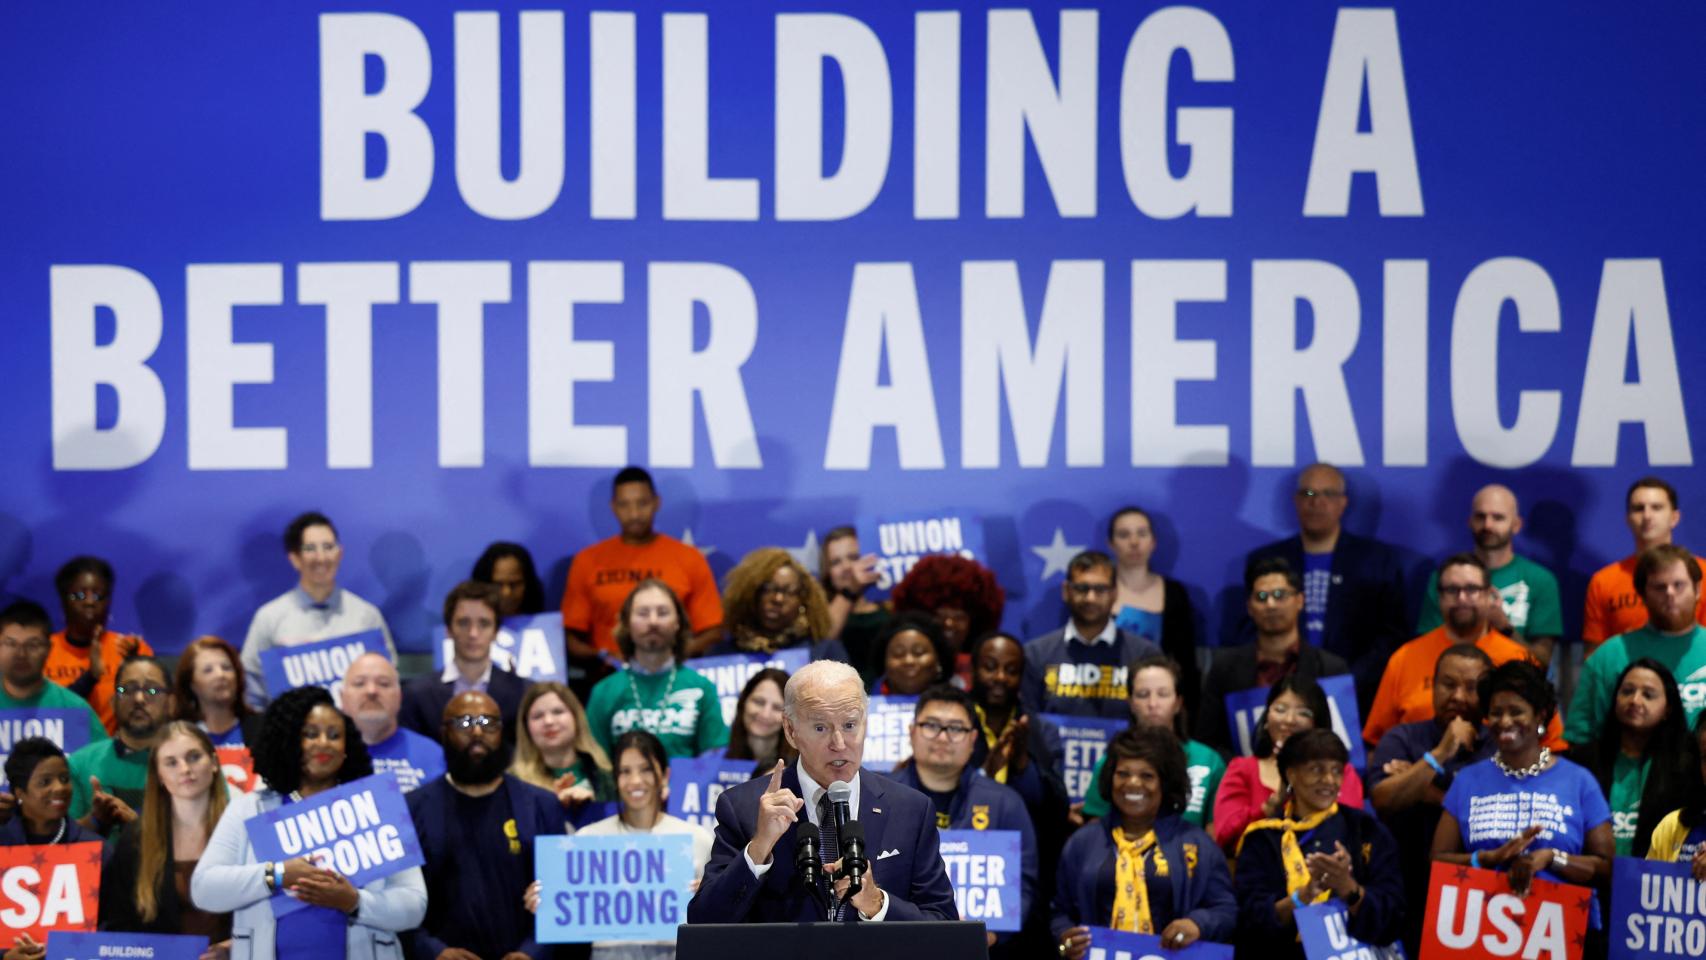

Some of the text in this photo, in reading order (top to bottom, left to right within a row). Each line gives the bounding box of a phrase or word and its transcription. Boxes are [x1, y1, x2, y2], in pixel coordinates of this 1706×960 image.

[319, 8, 1425, 220] BUILDING A
[50, 258, 1693, 471] BETTER AMERICA
[878, 517, 963, 555] UNION
[1059, 662, 1129, 686] BIDEN
[1519, 791, 1531, 801] to
[274, 790, 381, 855] UNION
[312, 823, 405, 877] RONG
[566, 849, 665, 885] UNION
[941, 854, 1005, 886] TTER
[554, 889, 678, 926] STRONG
[1436, 884, 1568, 960] USA
[99, 946, 154, 957] BUILDING
